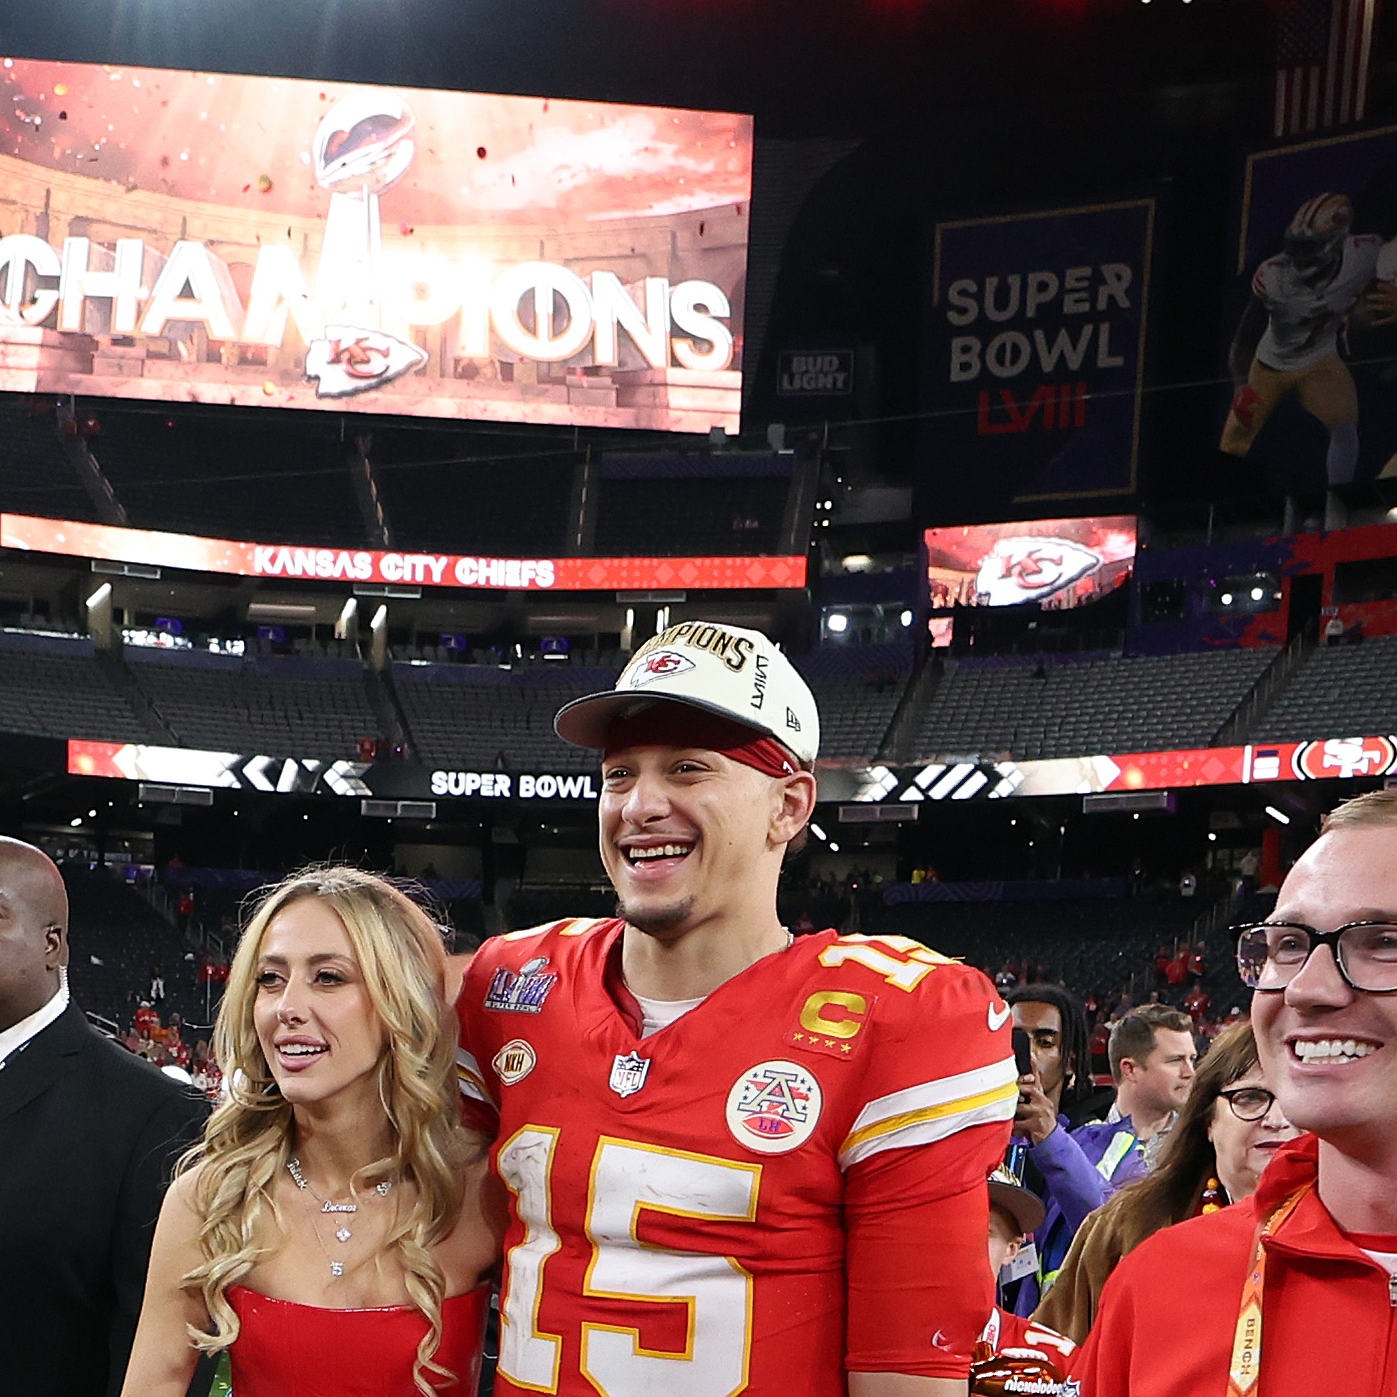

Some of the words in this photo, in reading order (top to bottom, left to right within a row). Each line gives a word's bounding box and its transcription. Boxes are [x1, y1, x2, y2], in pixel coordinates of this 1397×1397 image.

[947, 263, 1132, 326] SUPER
[791, 355, 840, 373] BUD
[950, 322, 1124, 382] BOWL
[782, 373, 847, 390] LIGHT
[254, 548, 372, 580] KANSAS
[380, 556, 447, 585] CITY
[455, 557, 555, 588] CHIEFS
[432, 770, 511, 798] SUPER
[519, 772, 597, 800] BOWL
[799, 990, 867, 1039] C
[616, 1071, 638, 1087] NFL
[1240, 1318, 1256, 1376] BENCH
